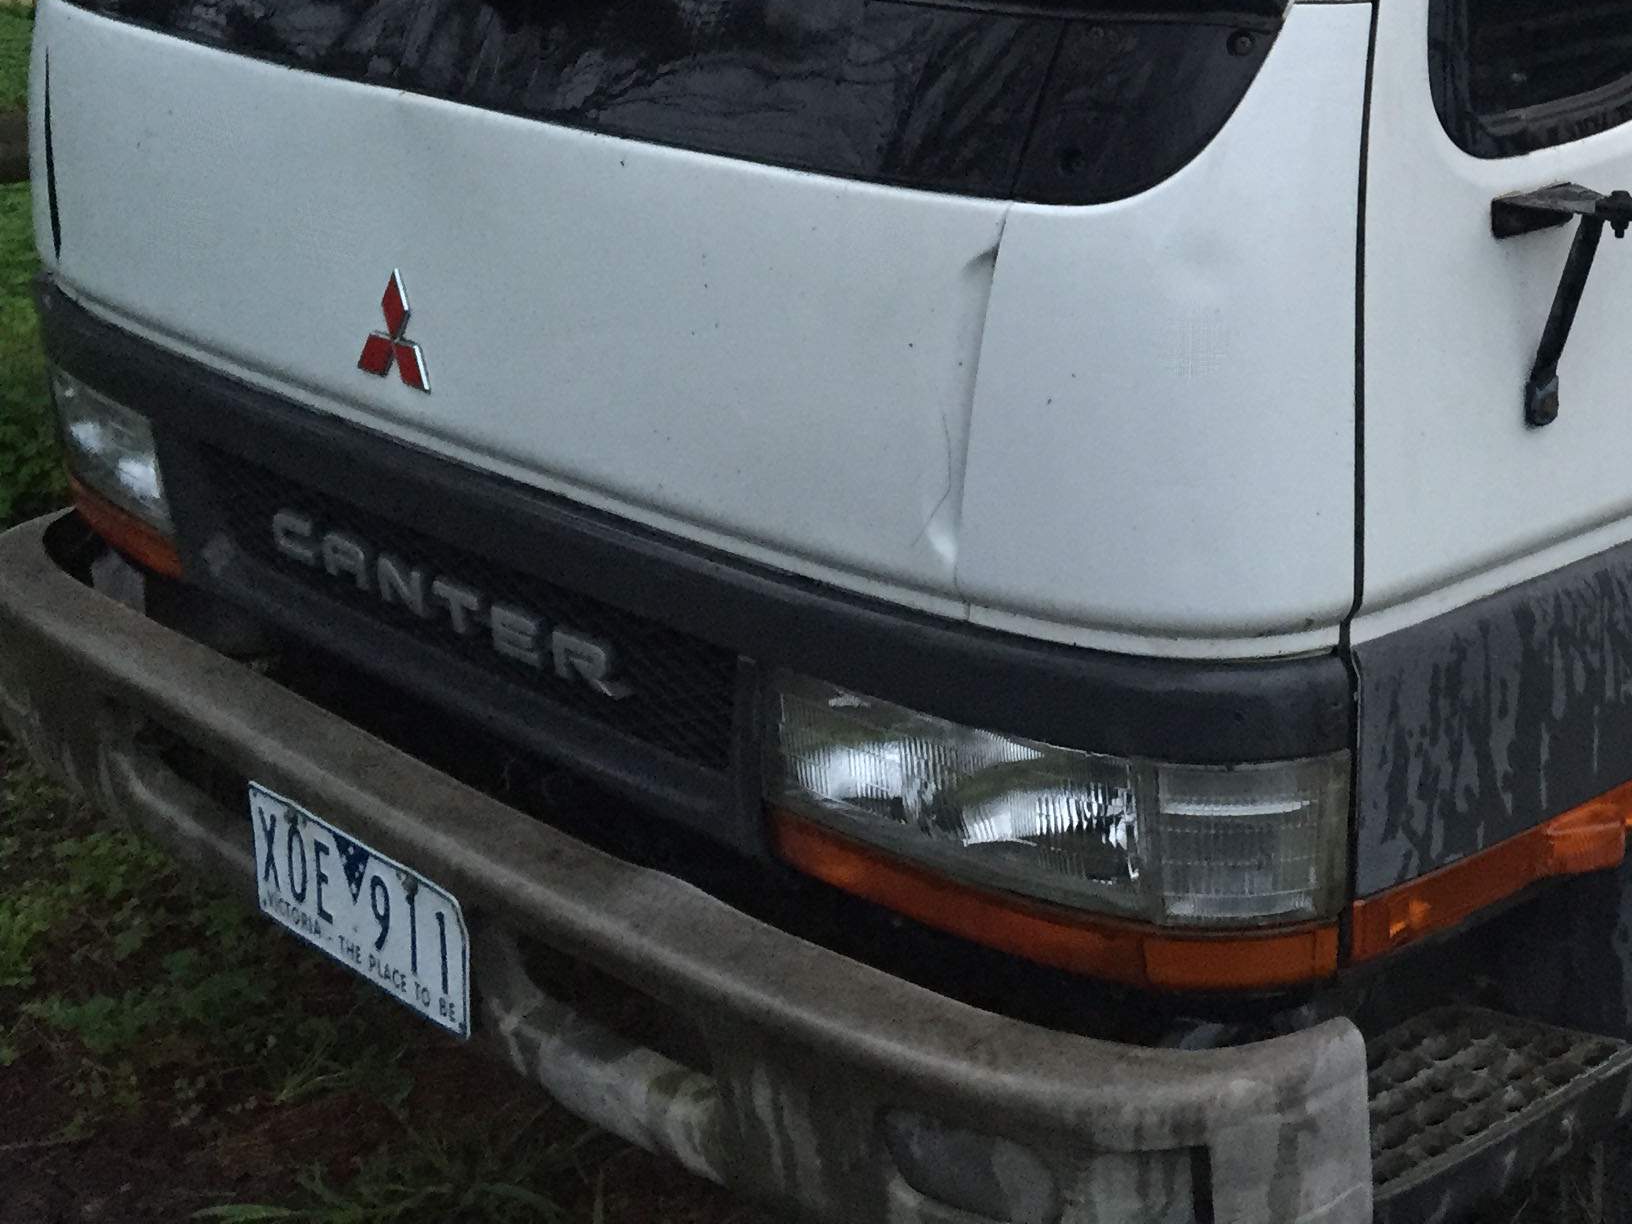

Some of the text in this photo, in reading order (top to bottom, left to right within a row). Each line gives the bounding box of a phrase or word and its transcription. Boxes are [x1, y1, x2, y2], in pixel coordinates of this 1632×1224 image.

[272, 511, 635, 699] CANTER
[259, 807, 448, 994] XOE 911
[267, 892, 321, 936] VICTORIA
[337, 933, 362, 965] THE
[368, 954, 407, 993] PLACE
[414, 982, 431, 1007] TO
[439, 996, 456, 1023] BE
